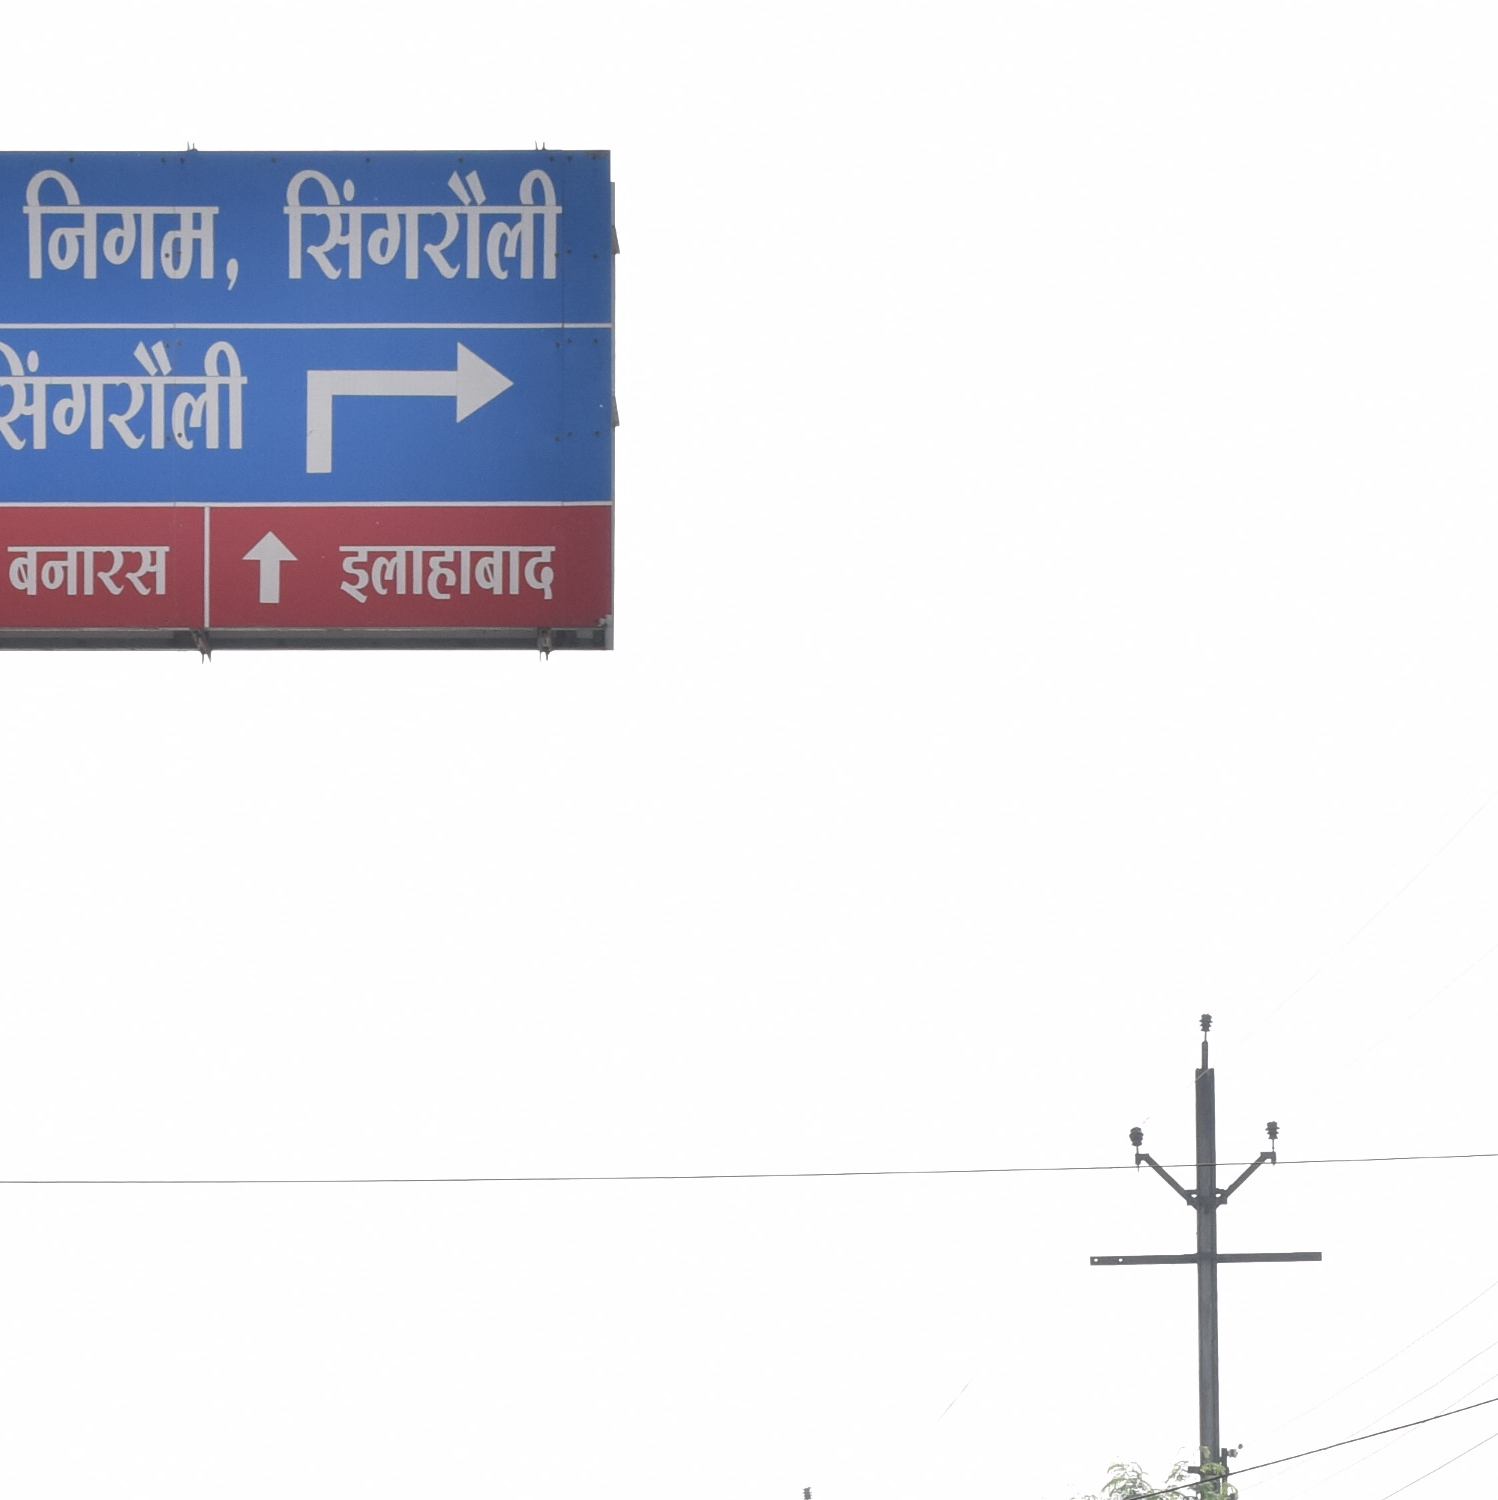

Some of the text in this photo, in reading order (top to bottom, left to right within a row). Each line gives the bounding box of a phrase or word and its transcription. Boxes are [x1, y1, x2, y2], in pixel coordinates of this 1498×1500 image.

[23, 168, 239, 291] निगम,
[283, 168, 563, 280] सिंगरौली
[8, 545, 170, 597] बनारस
[339, 545, 556, 604] इलाहाबाद
